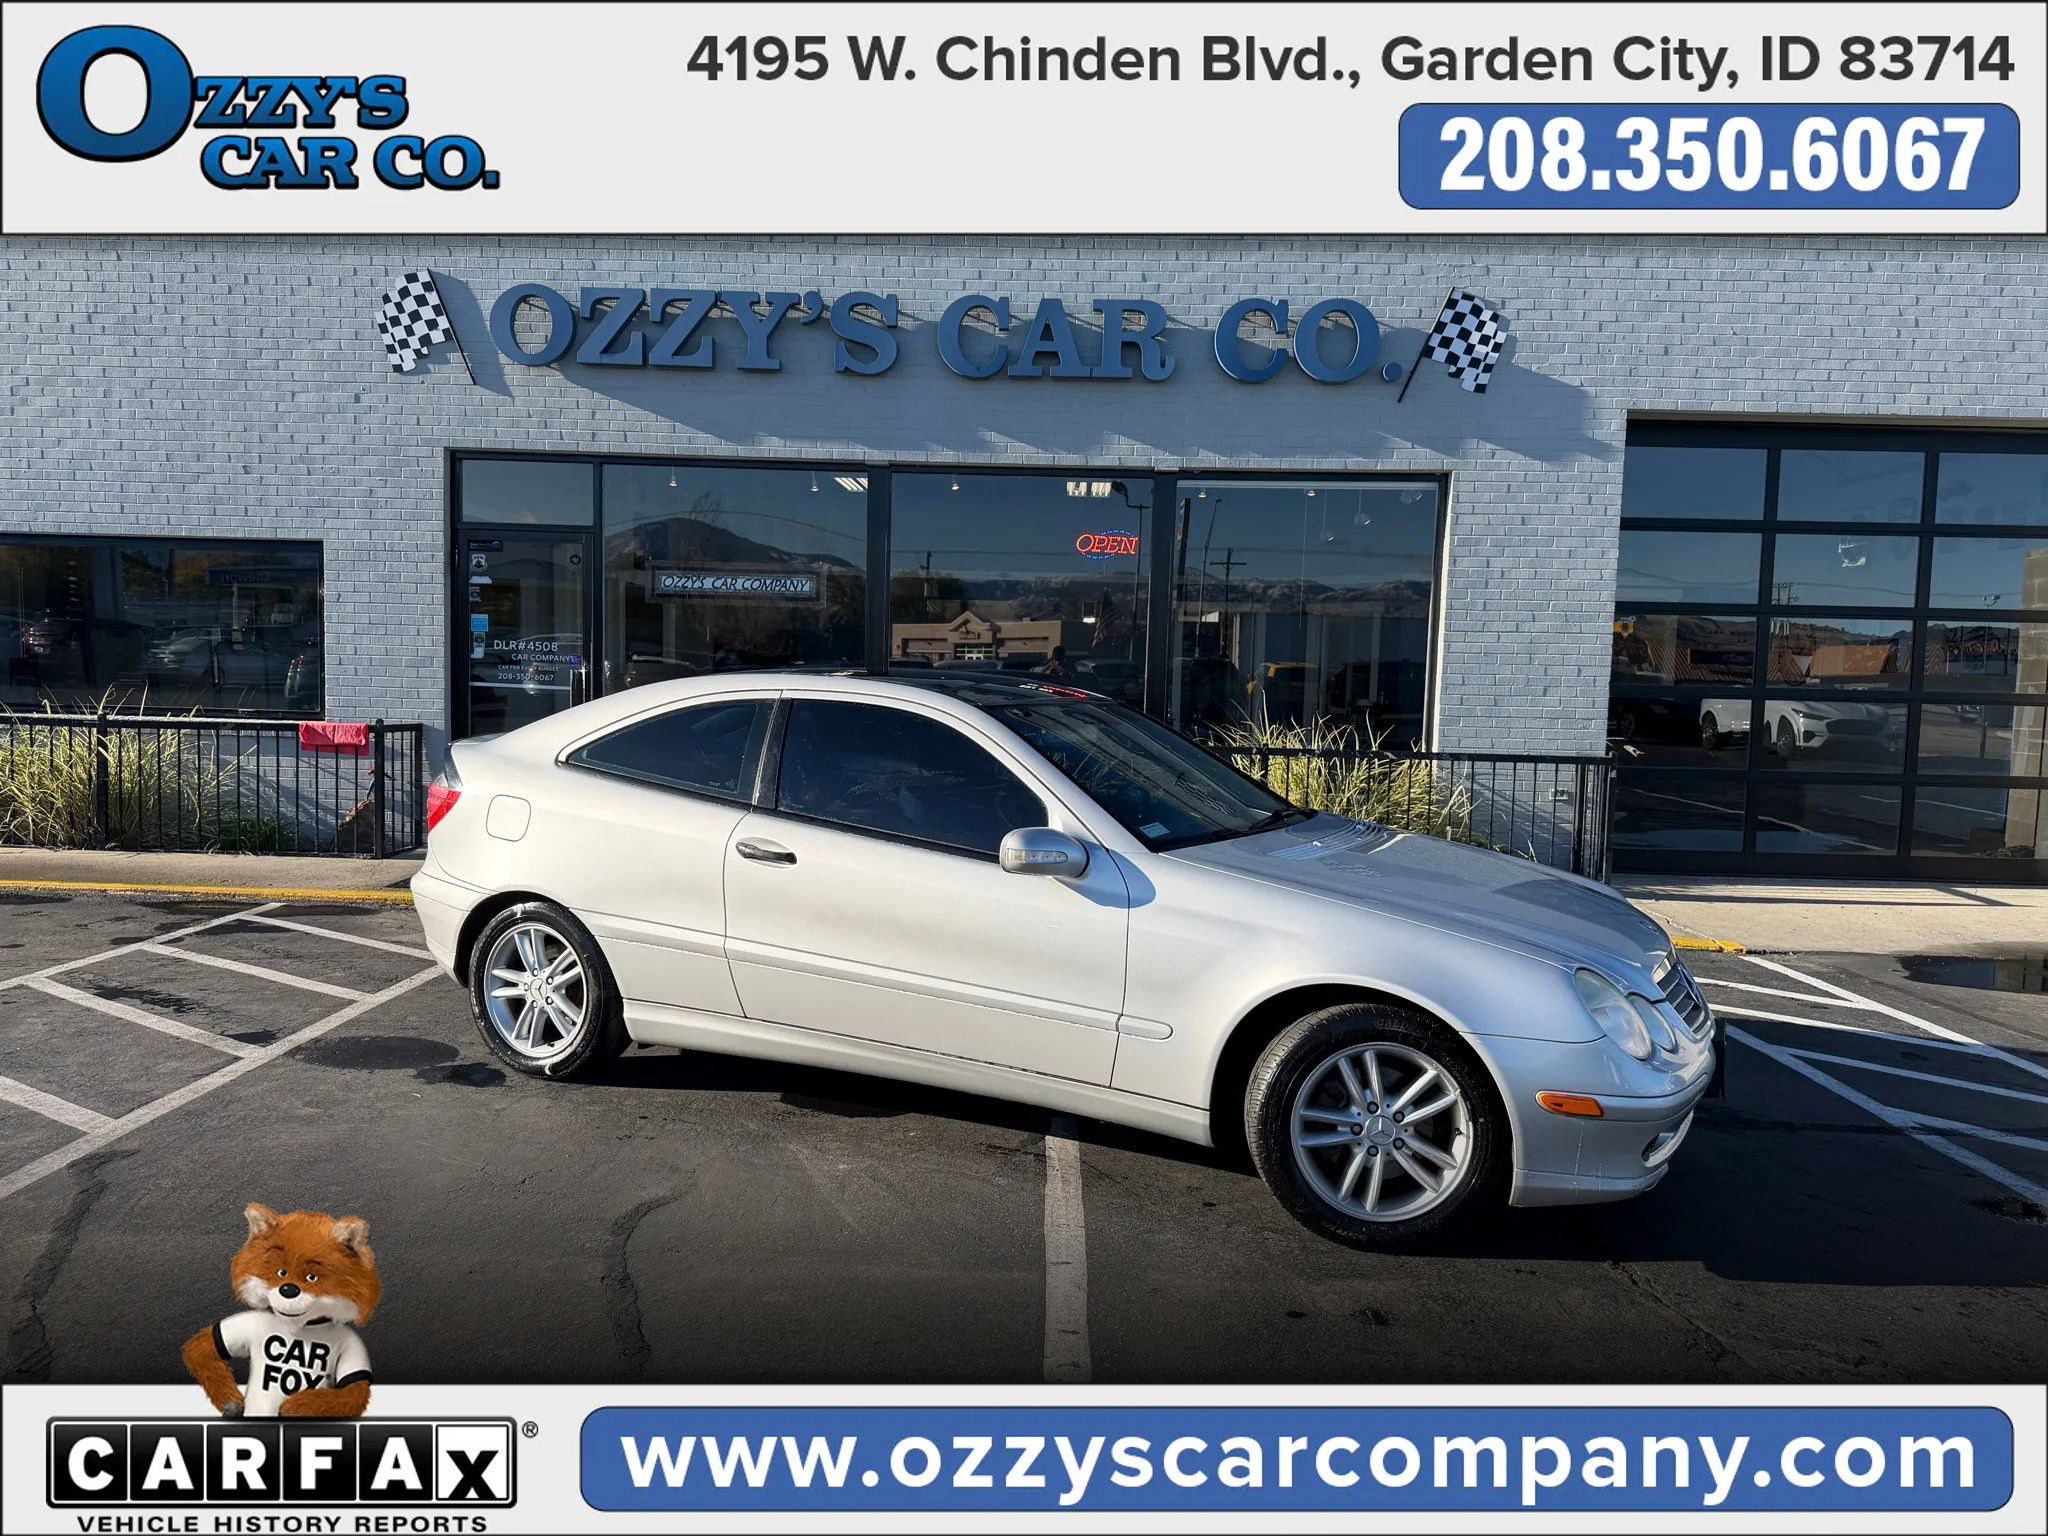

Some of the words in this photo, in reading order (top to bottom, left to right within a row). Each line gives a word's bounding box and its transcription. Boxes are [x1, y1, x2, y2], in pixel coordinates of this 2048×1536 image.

[490, 283, 898, 377] OZZY'S
[937, 294, 1176, 382] CAR
[1214, 297, 1403, 384] CO.
[1076, 534, 1139, 554] OPEN
[662, 575, 705, 589] OZZY'S
[711, 577, 738, 591] CAR
[741, 578, 809, 593] COMPANY
[493, 639, 559, 652] DLR#4508
[511, 653, 529, 661] CAR
[530, 654, 571, 663] COMPANY
[497, 672, 554, 681] 208-350-6067
